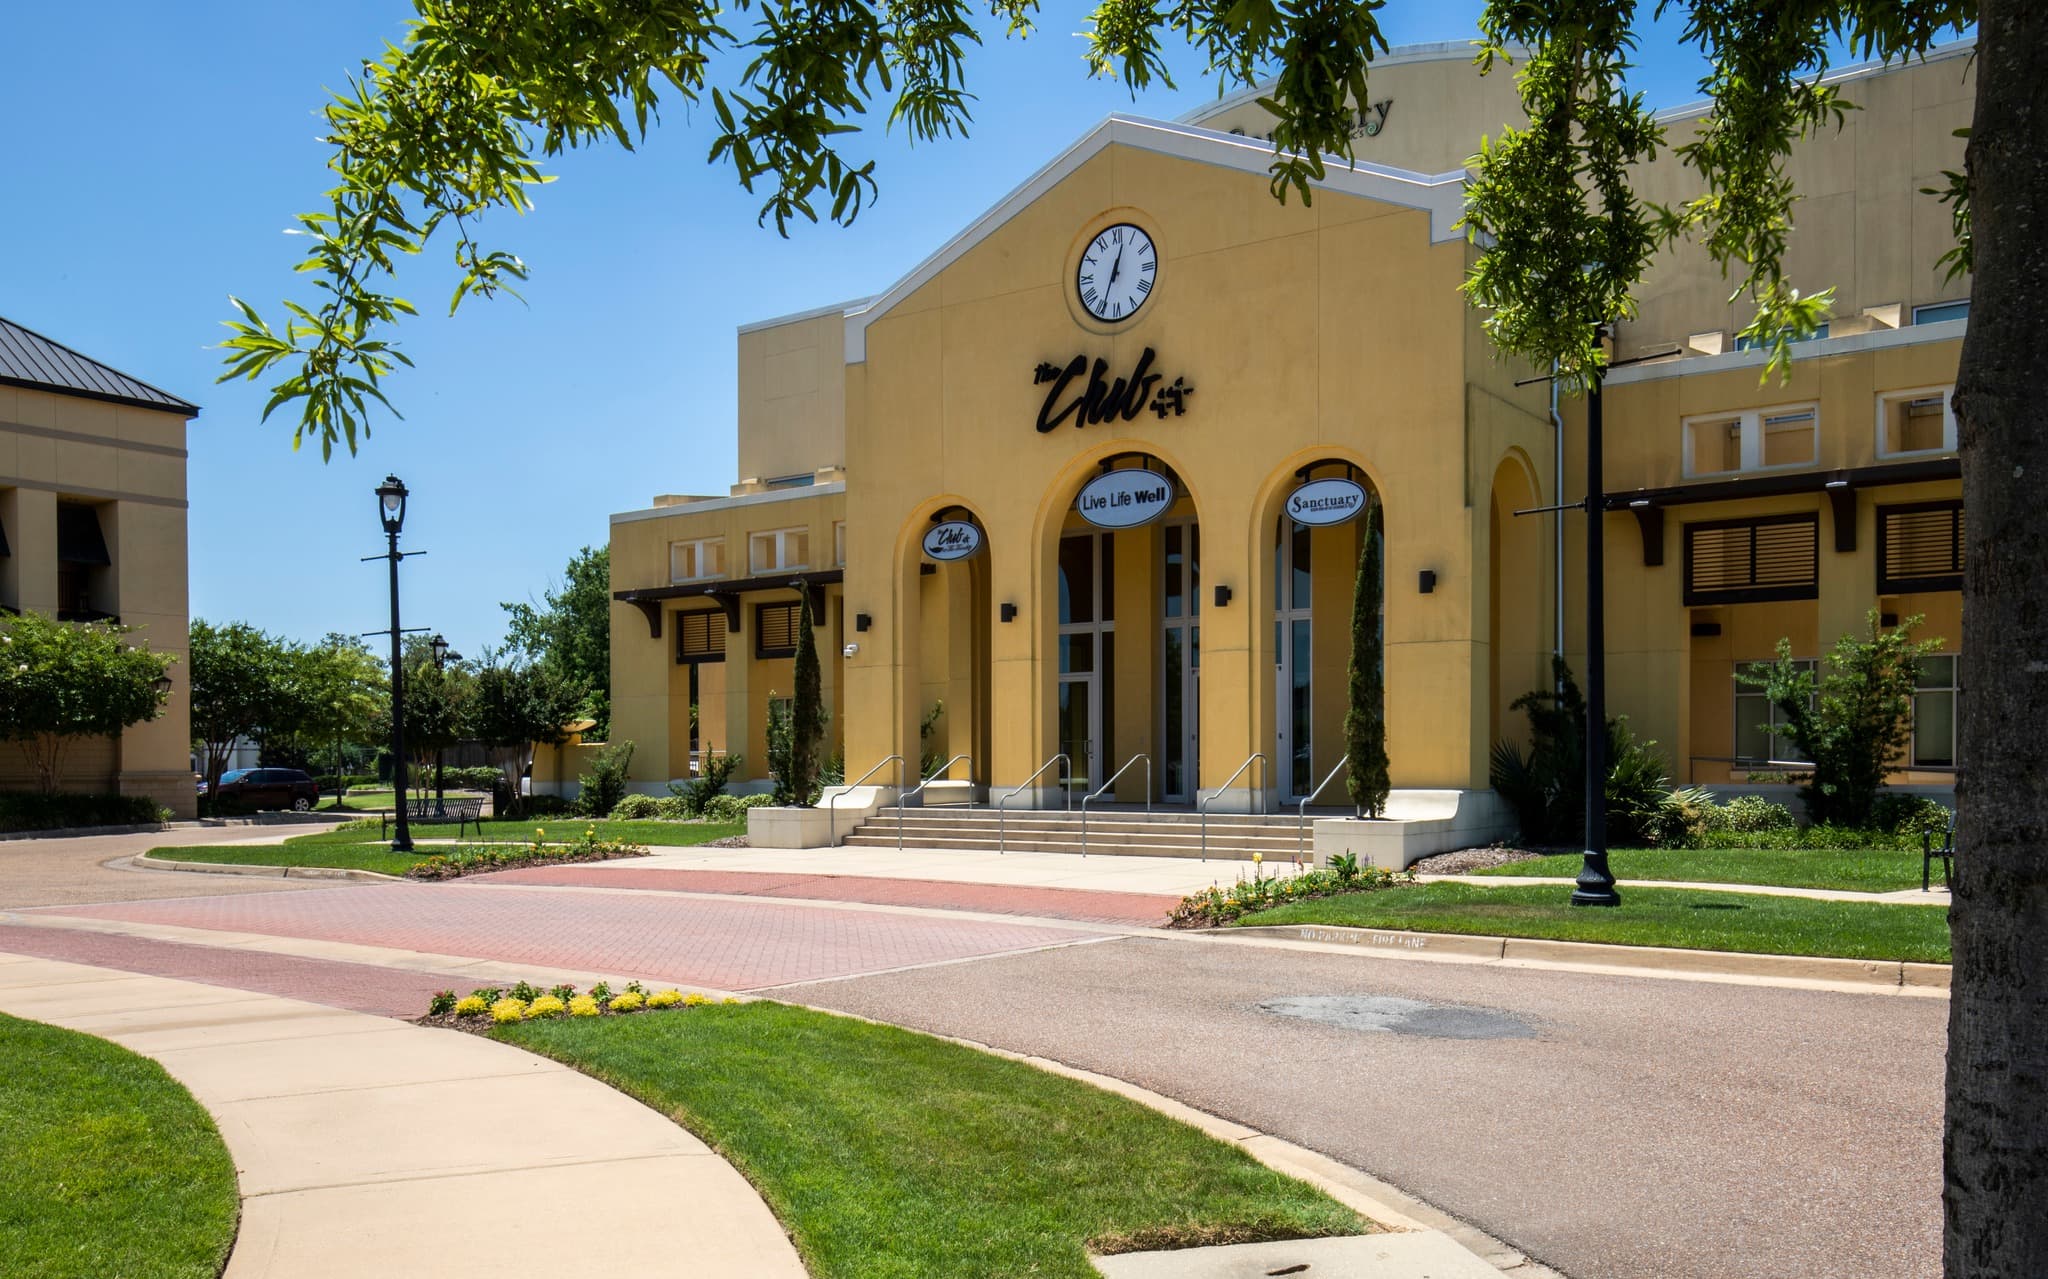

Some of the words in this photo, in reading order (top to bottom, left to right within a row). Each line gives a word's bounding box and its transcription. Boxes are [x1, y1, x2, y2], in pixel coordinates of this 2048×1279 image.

[1036, 347, 1162, 433] Club
[1083, 495, 1107, 510] Live
[1110, 491, 1131, 507] Life
[1135, 487, 1165, 504] Well
[1292, 495, 1359, 513] Sanctuary
[938, 527, 965, 545] Club
